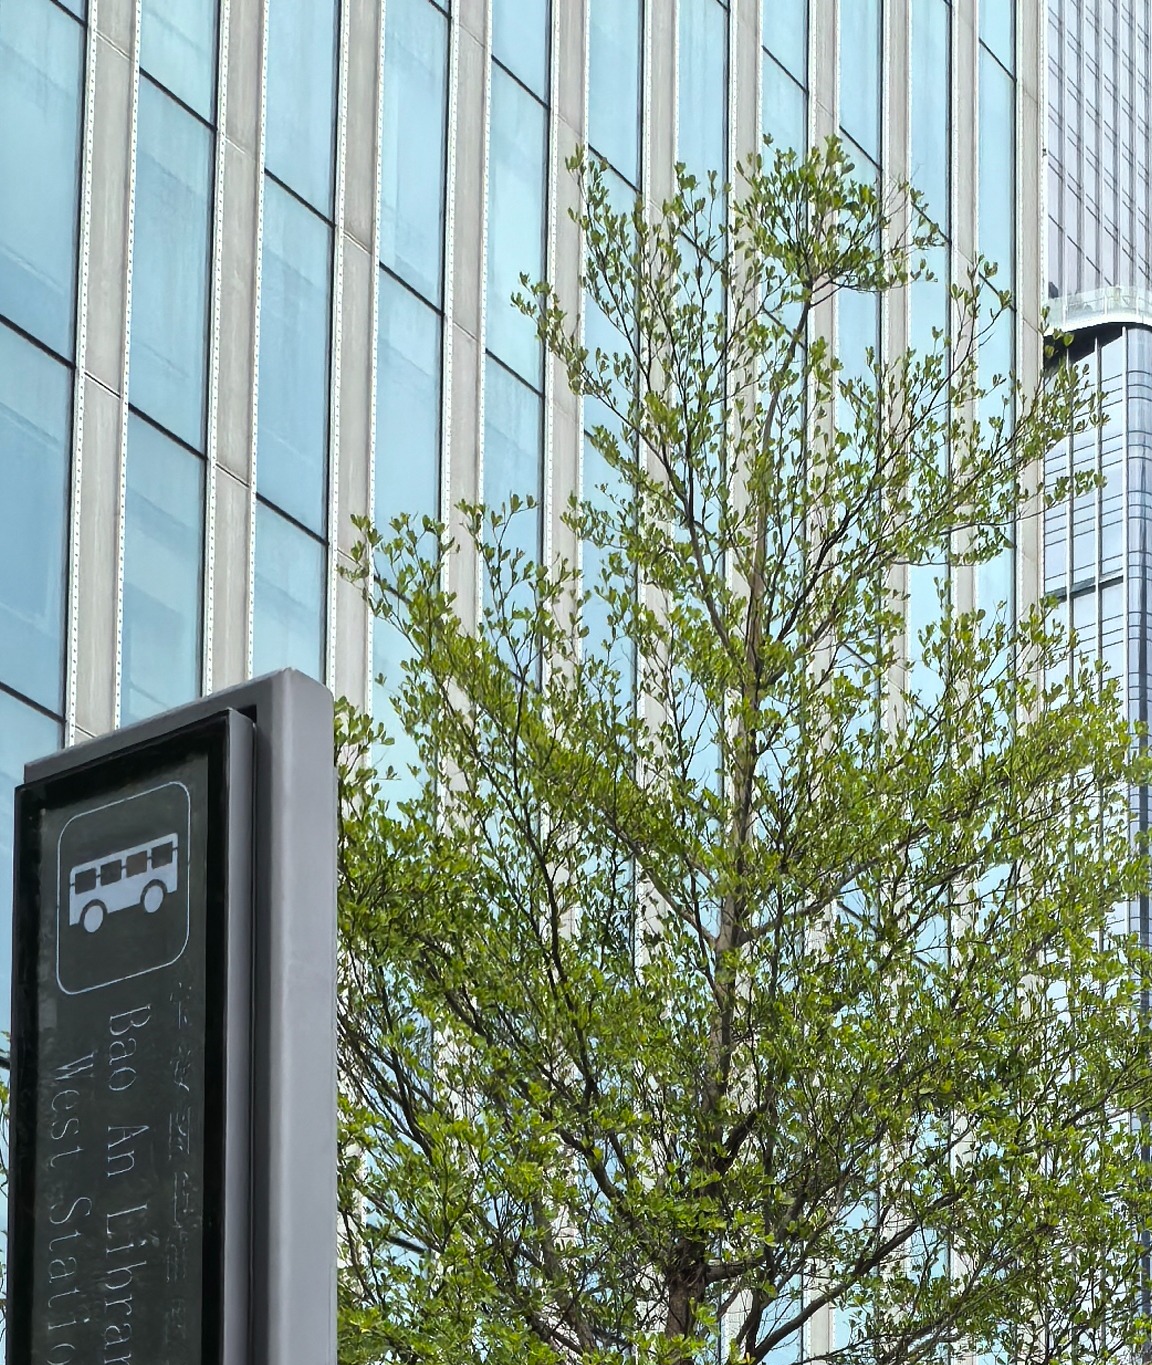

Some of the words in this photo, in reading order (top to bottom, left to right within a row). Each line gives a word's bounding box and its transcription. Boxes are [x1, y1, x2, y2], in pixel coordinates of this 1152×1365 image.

[108, 1003, 152, 1092] Bao
[49, 1049, 98, 1169] West
[107, 1125, 150, 1178] An
